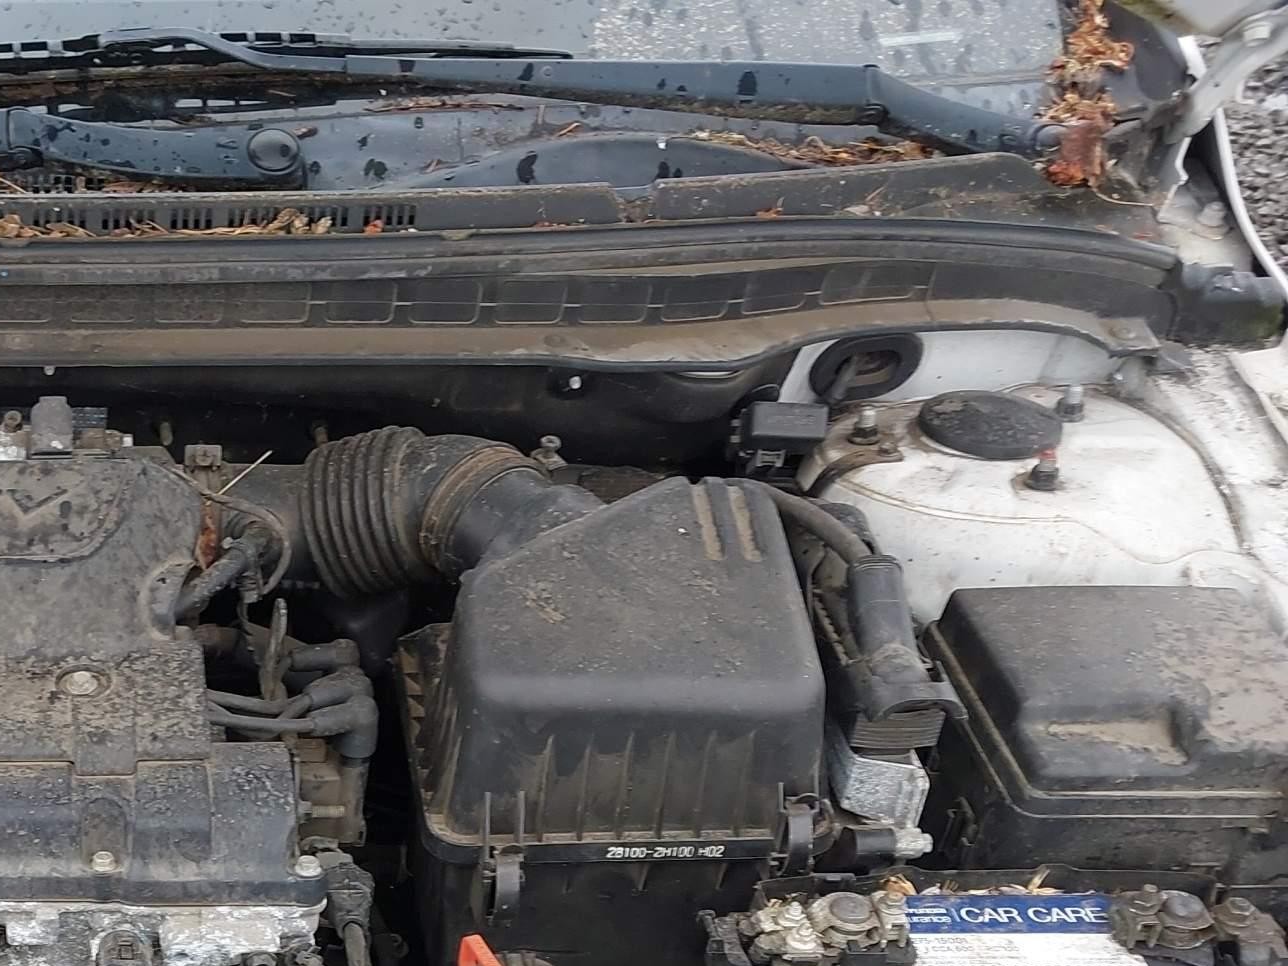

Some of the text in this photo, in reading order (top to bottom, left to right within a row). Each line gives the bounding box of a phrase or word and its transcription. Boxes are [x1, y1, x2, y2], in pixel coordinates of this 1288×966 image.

[606, 846, 694, 858] 28100-2H100
[960, 907, 1107, 923] CAR CARE
